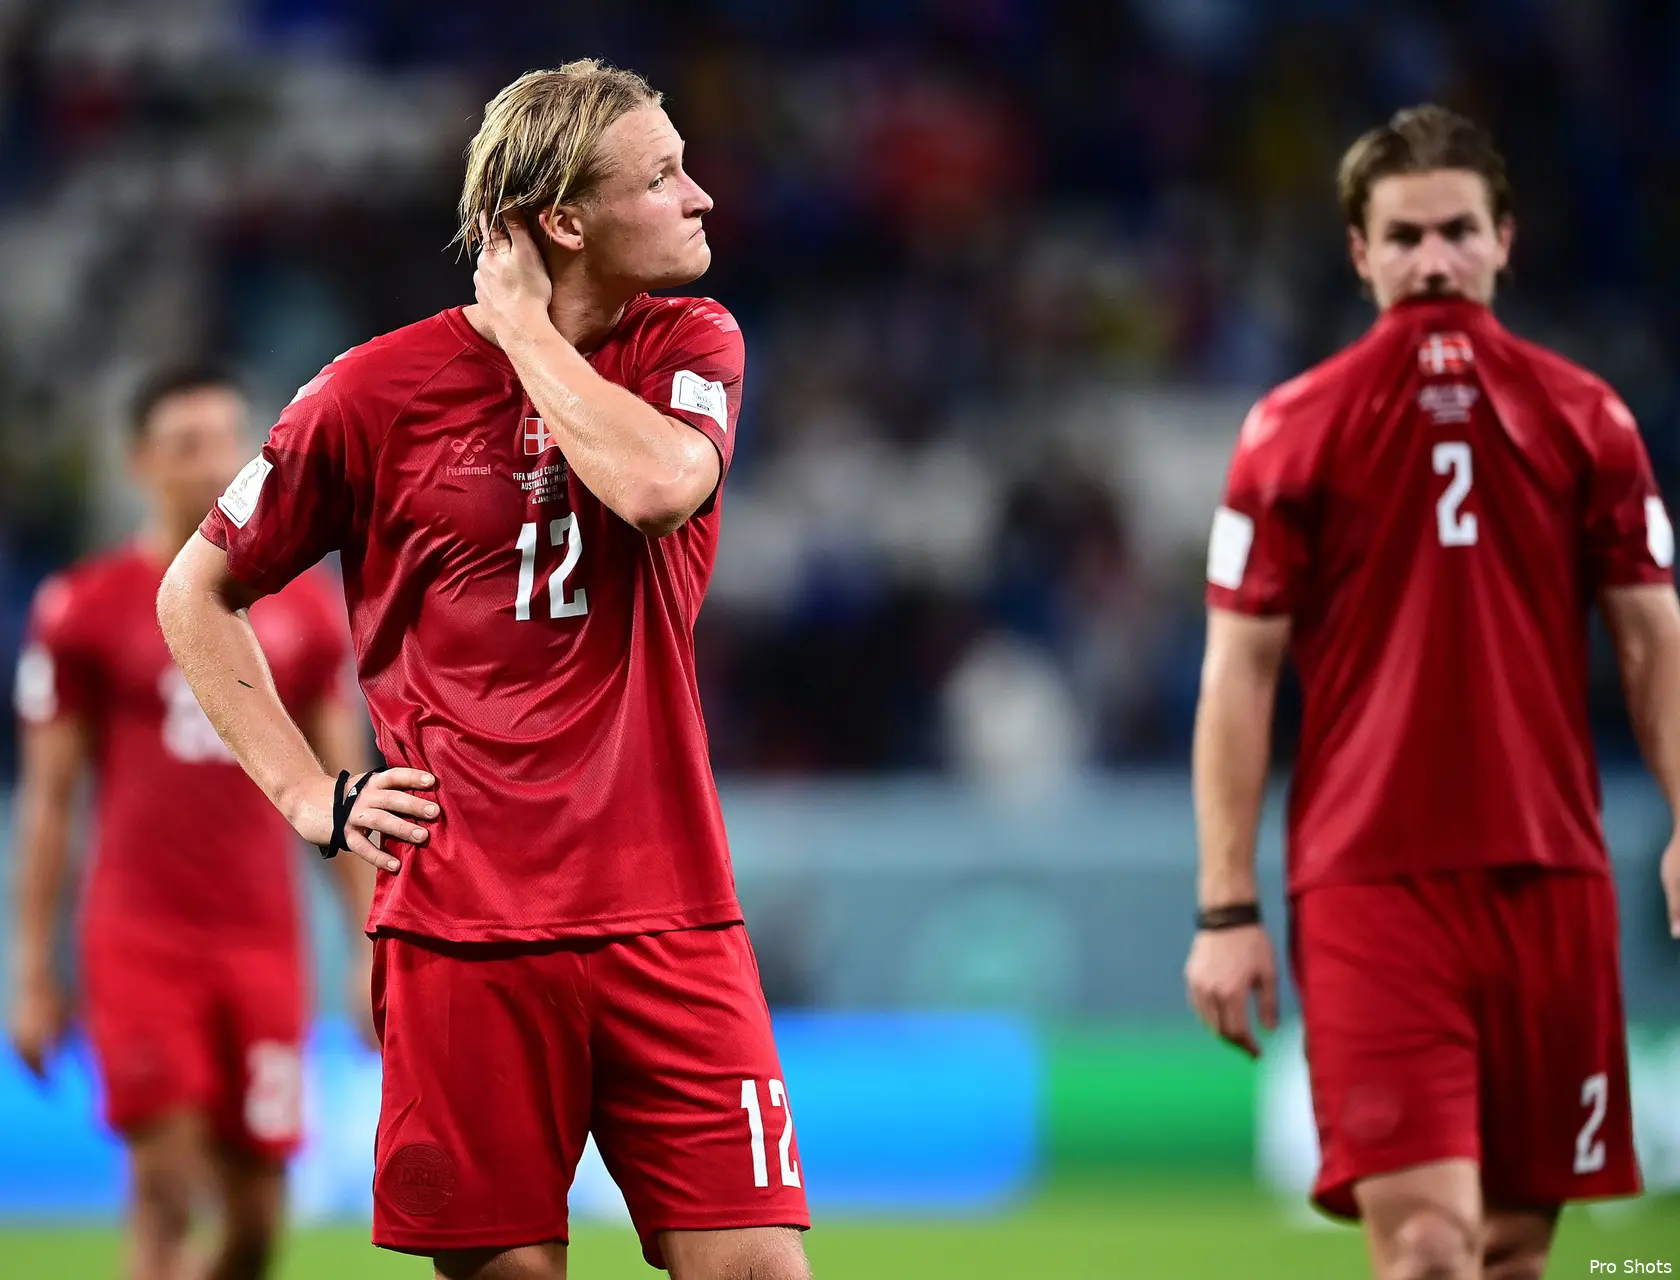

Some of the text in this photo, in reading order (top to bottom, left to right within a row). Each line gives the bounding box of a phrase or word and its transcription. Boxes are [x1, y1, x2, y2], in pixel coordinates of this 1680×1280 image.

[446, 464, 491, 477] hummel
[513, 472, 526, 481] FIFA
[527, 468, 543, 480] WORLD
[521, 477, 549, 490] AUSTRALIA
[1432, 441, 1478, 547] 2
[515, 511, 588, 621] 12
[741, 1078, 801, 1188] 12
[1573, 1072, 1609, 1175] 2
